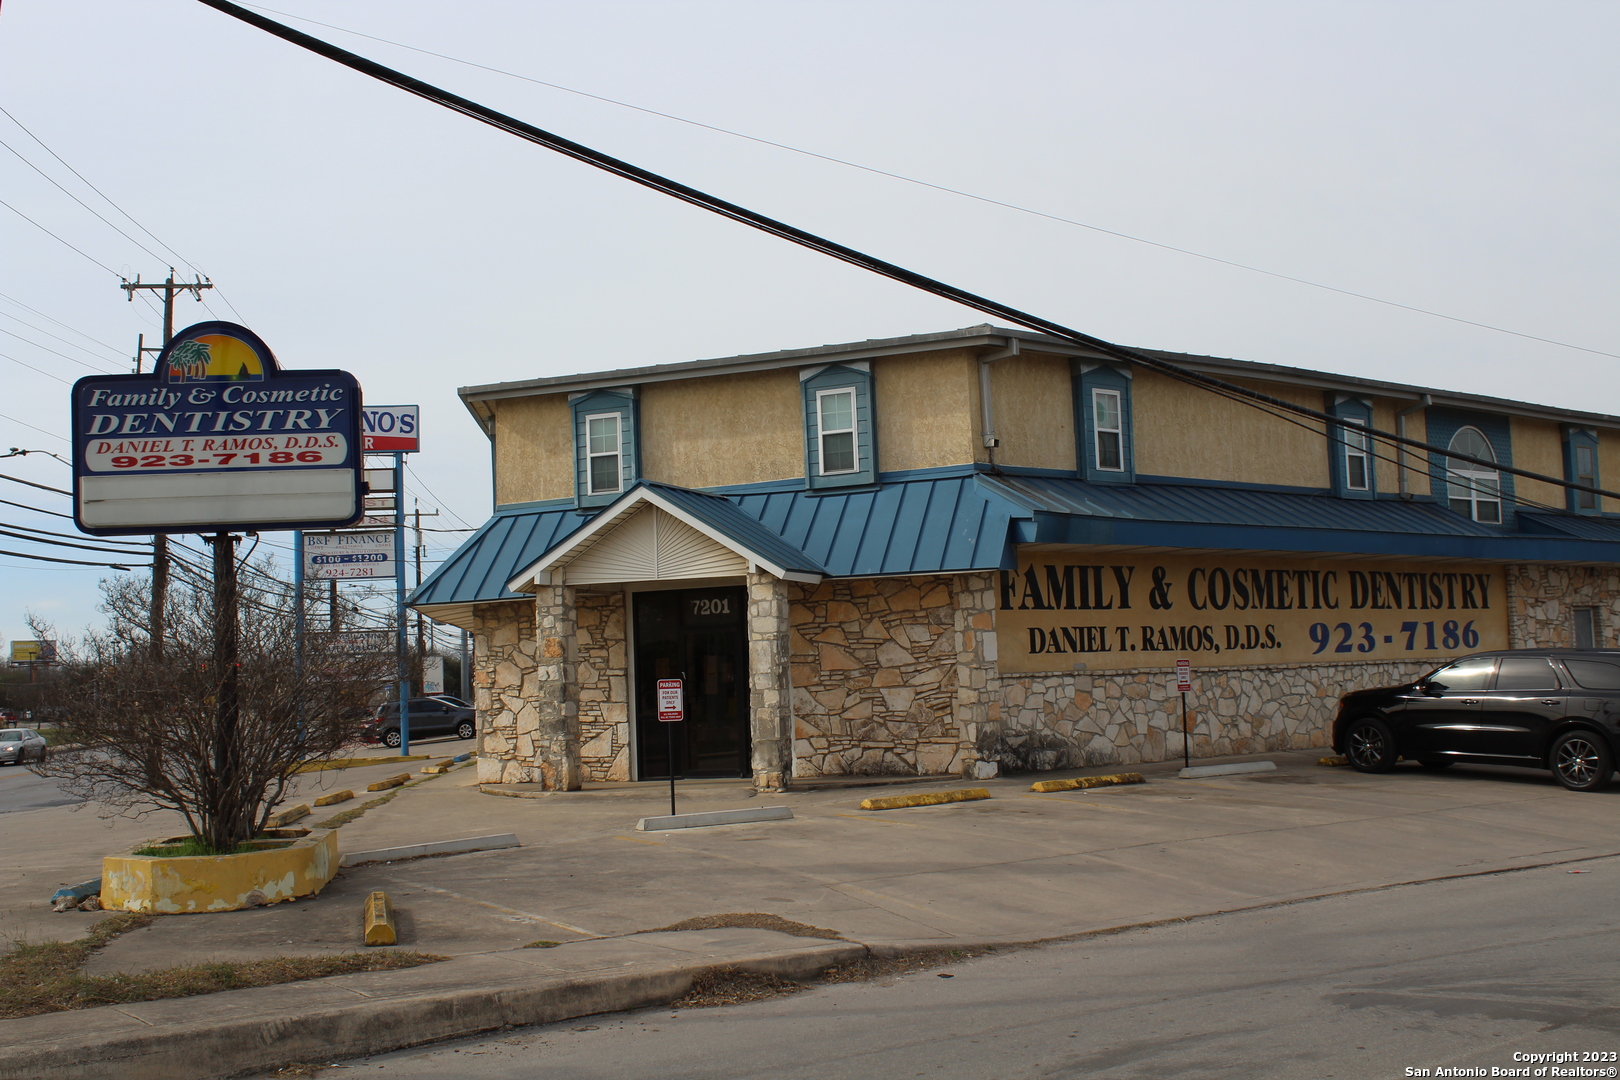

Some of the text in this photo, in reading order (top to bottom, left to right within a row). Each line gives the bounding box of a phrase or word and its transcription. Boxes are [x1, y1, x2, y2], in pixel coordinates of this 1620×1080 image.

[88, 383, 344, 410] Family & Cosmetic
[85, 408, 345, 436] DENTISTRY
[96, 435, 339, 455] DANIEL T. RAMOS, D.D.S.
[111, 450, 323, 468] 923-7186
[308, 534, 391, 546] B&F FINANCE
[316, 556, 341, 564] $100
[352, 554, 383, 562] $1200
[325, 567, 374, 577] 924-7281
[999, 563, 1491, 611] FAMILY & COSMETIC DENTISTRY
[690, 598, 730, 615] 7201
[1027, 624, 1282, 654] DANIEL T. RAMOS, D.D.S.
